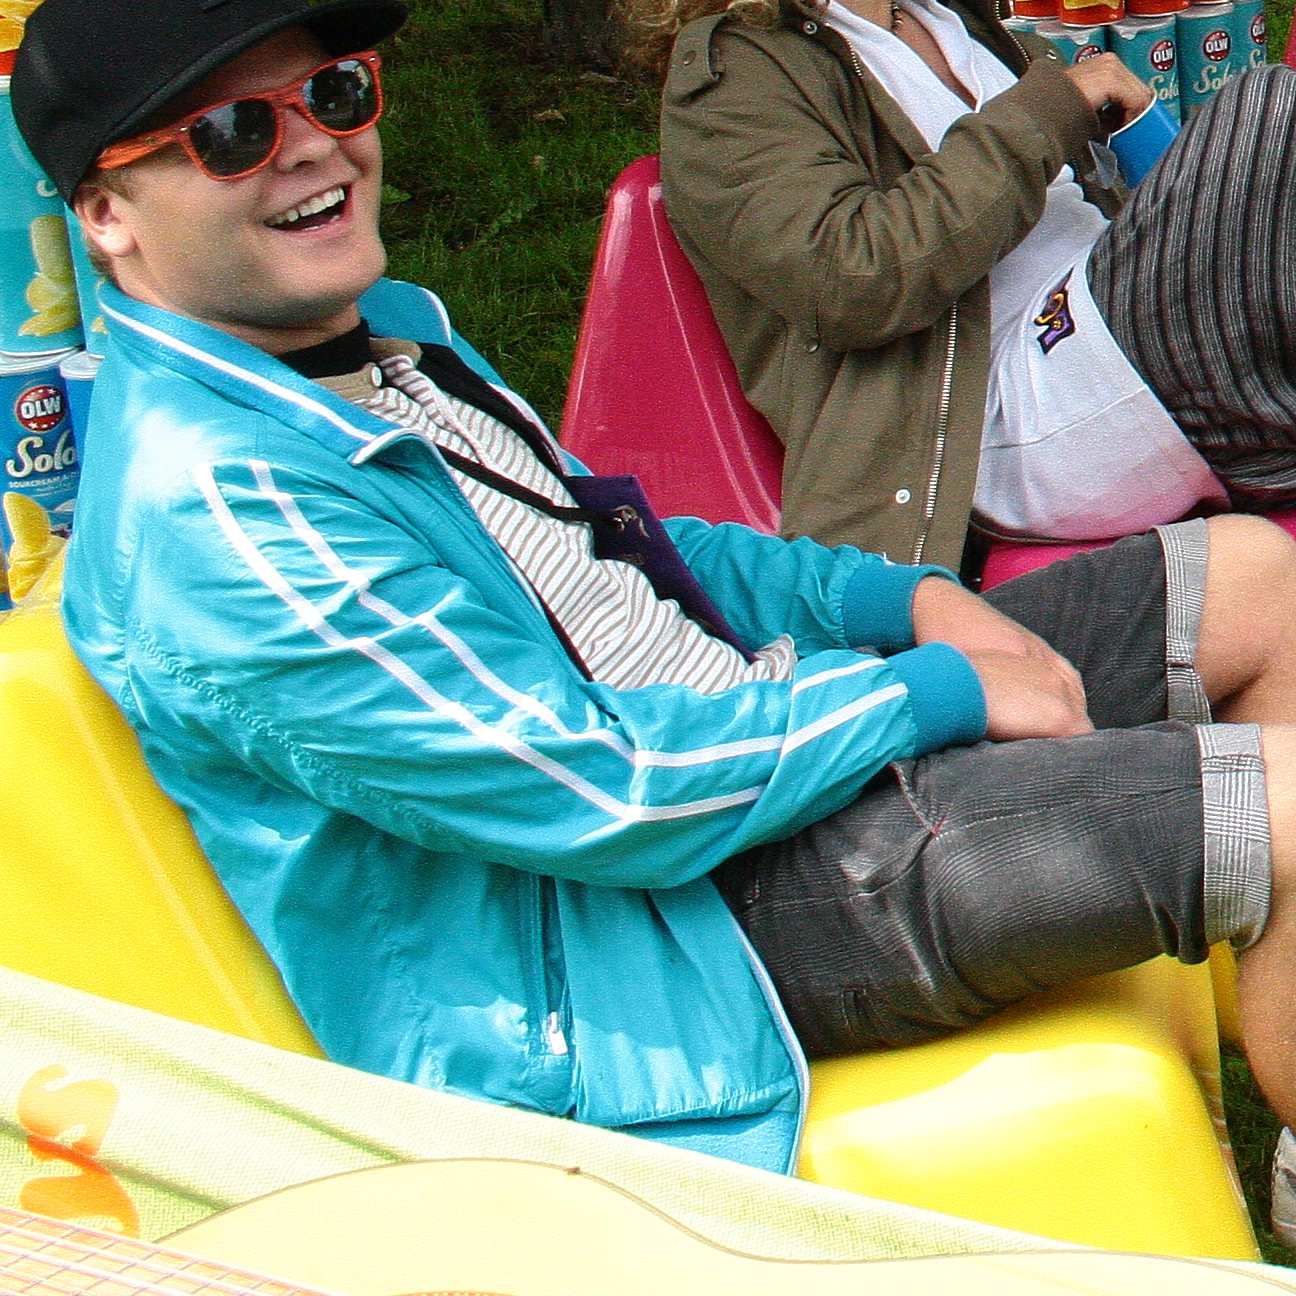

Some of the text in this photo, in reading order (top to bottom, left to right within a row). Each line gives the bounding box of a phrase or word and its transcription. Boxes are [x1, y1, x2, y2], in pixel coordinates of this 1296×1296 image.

[1205, 36, 1228, 54] OLW
[20, 395, 62, 420] OLW
[6, 430, 78, 478] Sola
